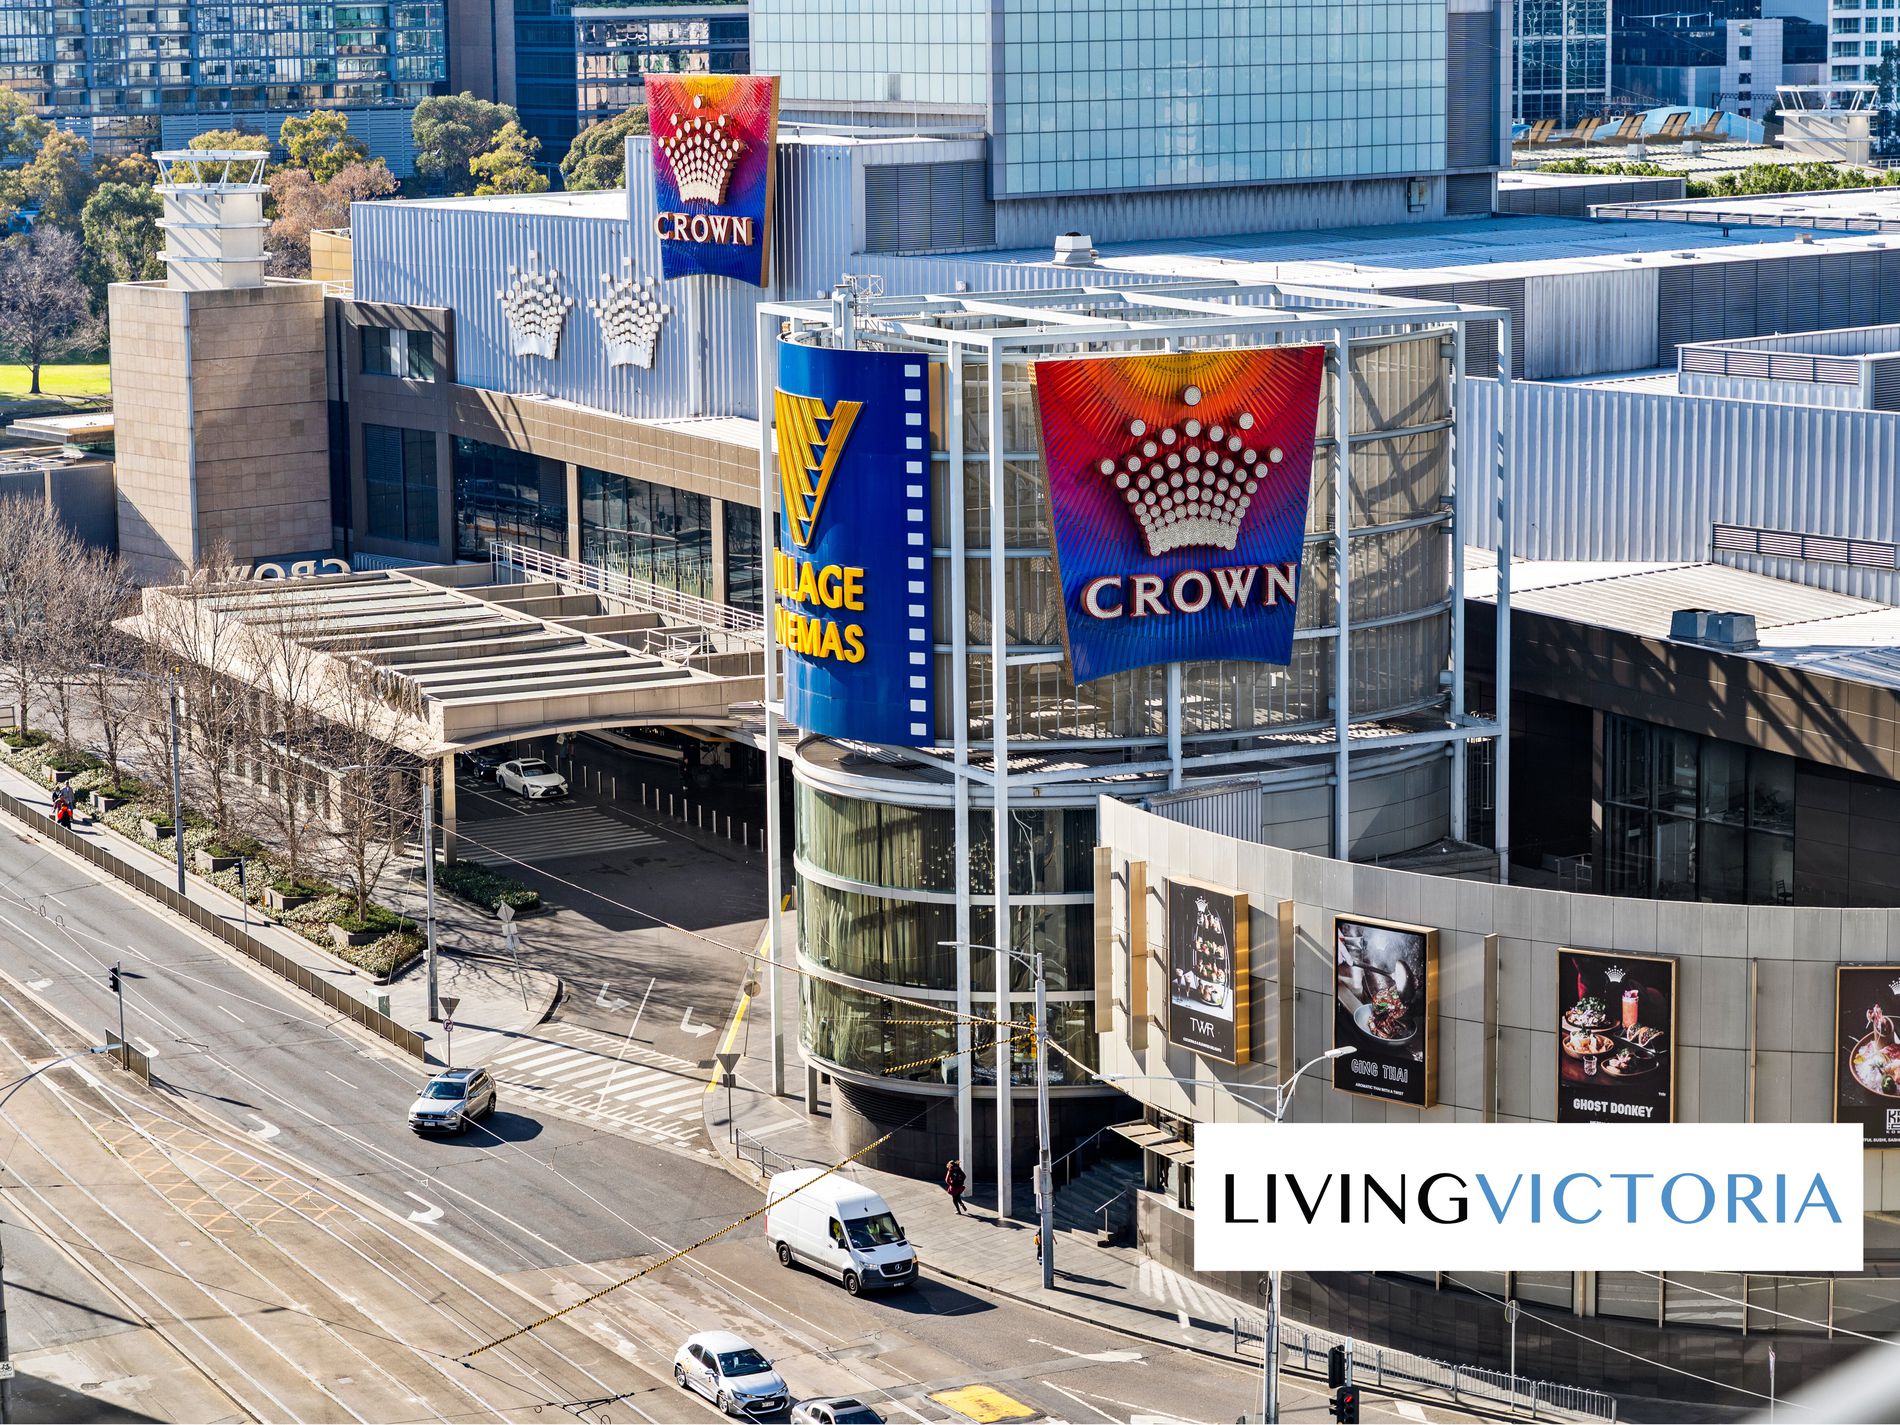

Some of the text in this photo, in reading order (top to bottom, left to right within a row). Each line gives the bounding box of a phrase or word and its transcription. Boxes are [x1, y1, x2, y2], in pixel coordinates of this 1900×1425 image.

[654, 211, 753, 246] CROWN
[773, 546, 865, 611] ILLAGE
[1080, 562, 1298, 620] CROWN
[1189, 1017, 1215, 1038] TWR
[1573, 1098, 1608, 1113] GHOST
